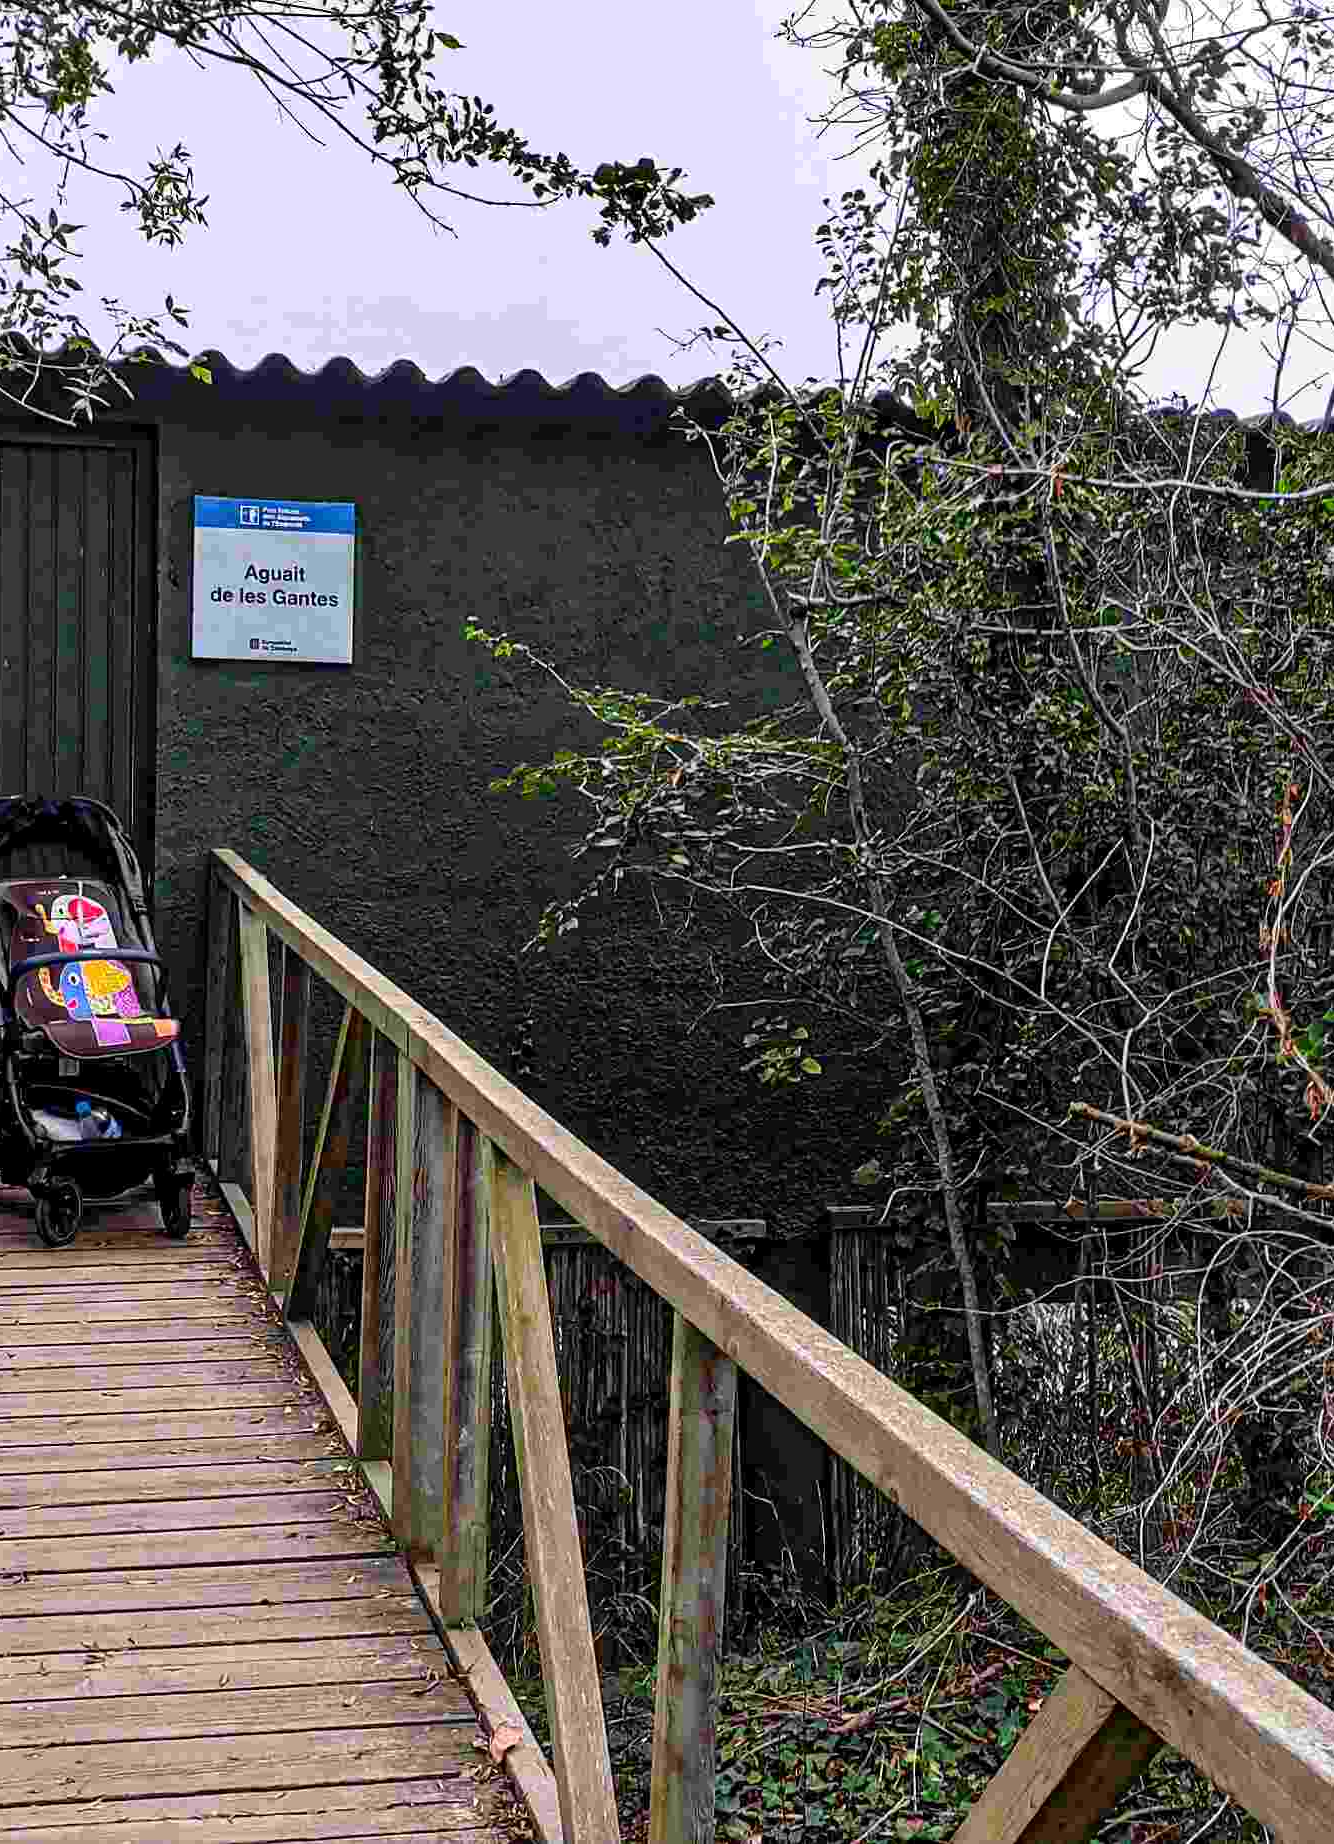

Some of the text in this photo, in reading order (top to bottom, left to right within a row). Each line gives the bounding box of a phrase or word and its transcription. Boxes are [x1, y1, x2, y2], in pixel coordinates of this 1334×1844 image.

[244, 564, 307, 584] Aguait
[210, 587, 339, 607] de les Gantes
